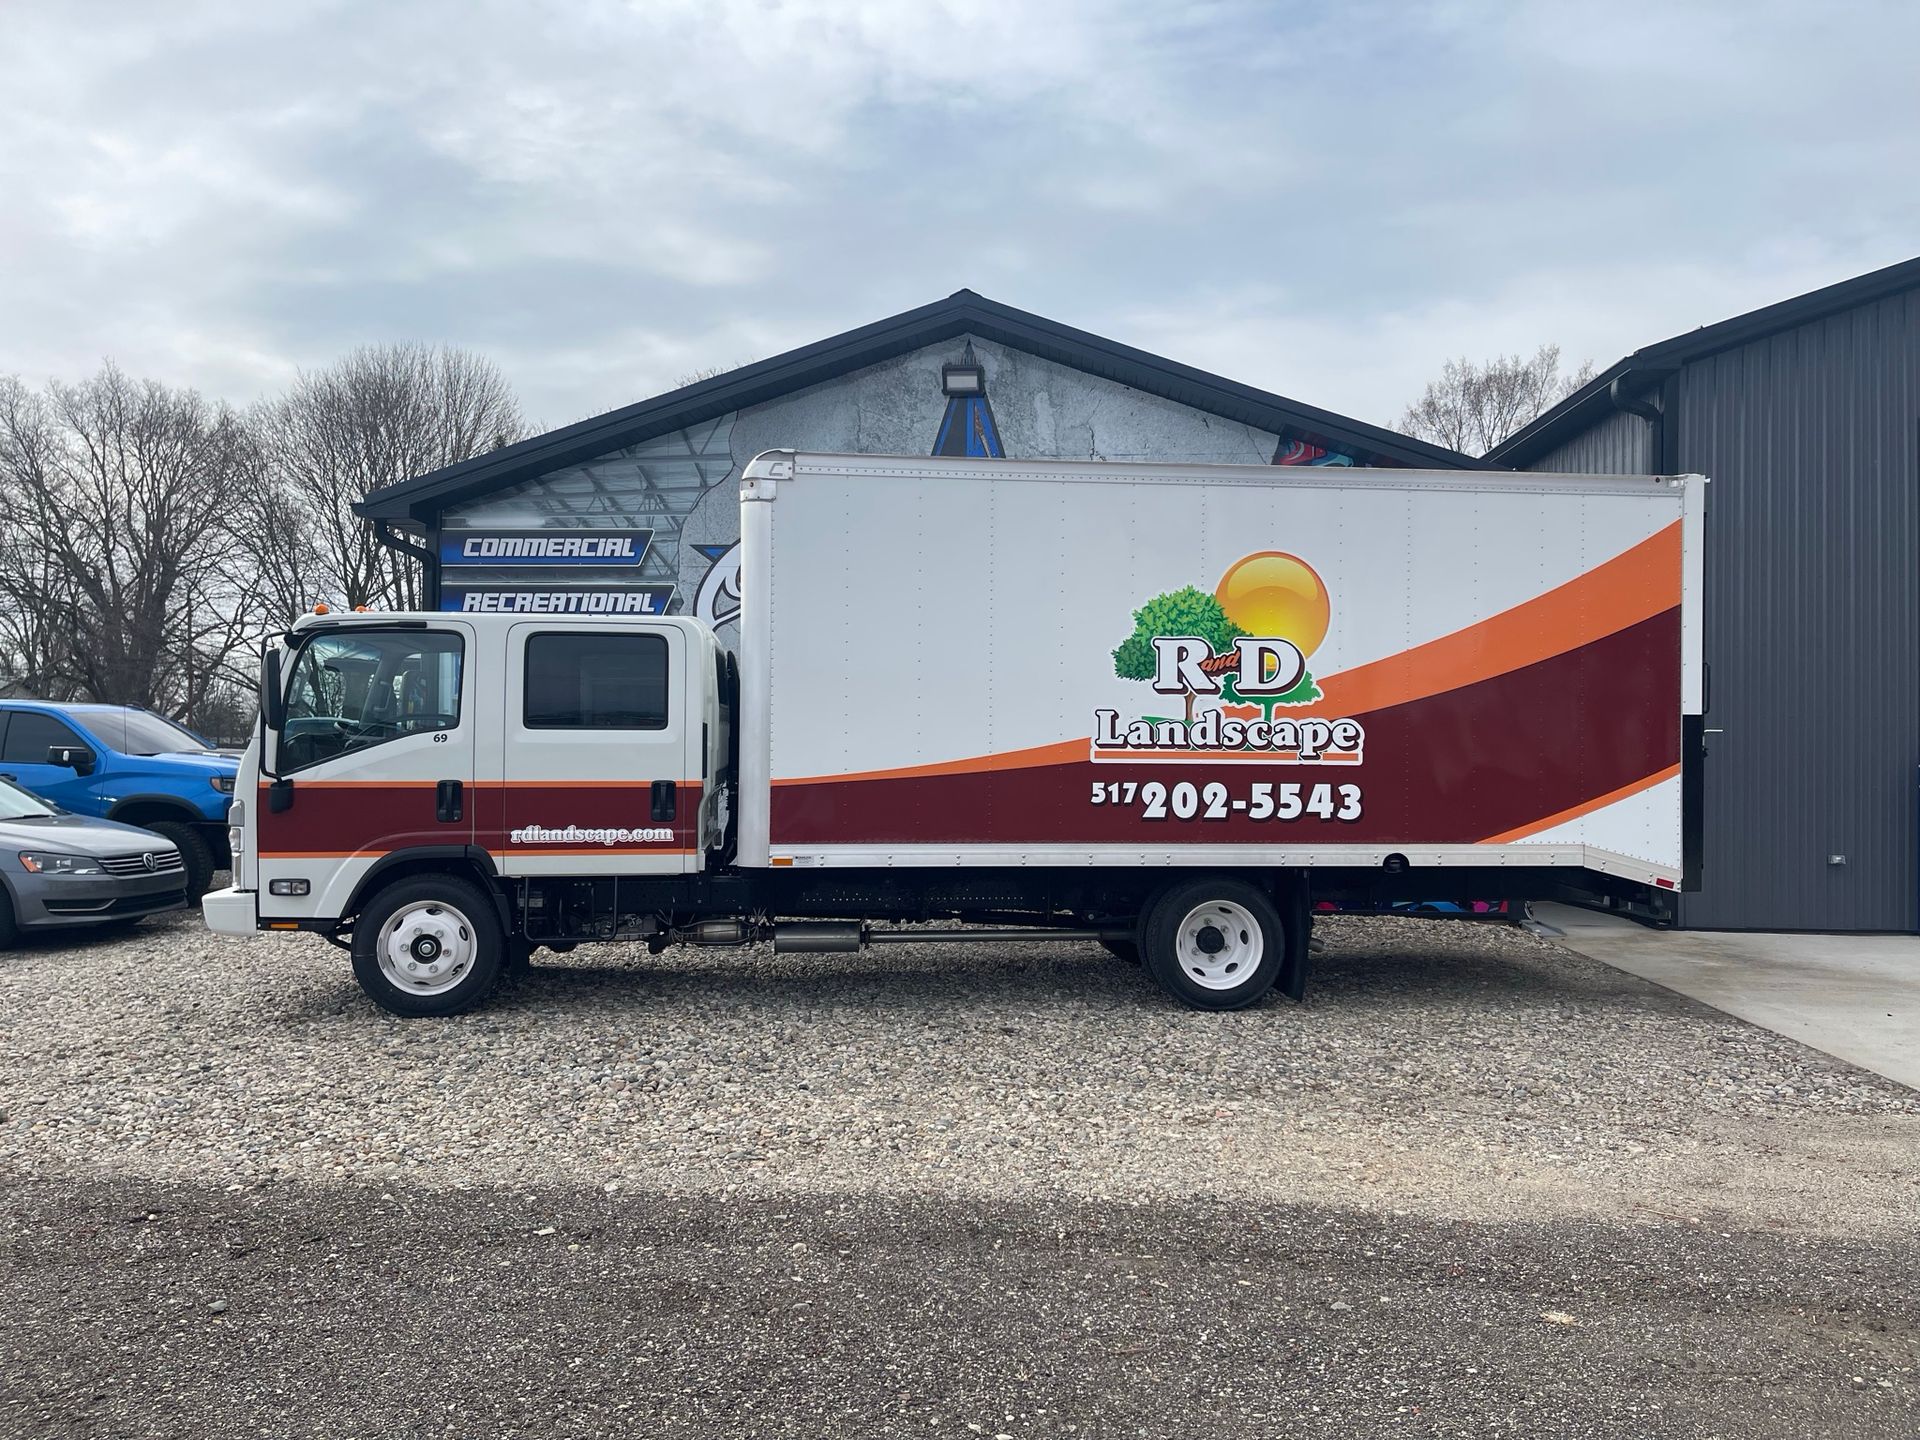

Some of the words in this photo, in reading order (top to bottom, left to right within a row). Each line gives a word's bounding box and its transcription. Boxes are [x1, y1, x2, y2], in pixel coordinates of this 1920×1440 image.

[462, 537, 635, 558] COMMERCIAL
[462, 592, 655, 613] RECREATIONAL
[1152, 637, 1221, 695] R
[1200, 650, 1241, 673] and
[1233, 637, 1305, 695] D
[433, 733, 448, 743] 69
[1095, 708, 1360, 760] Landscape
[1090, 782, 1138, 804] 517
[1141, 781, 1363, 821] 202-5543
[510, 825, 674, 846] rdlandscape.com
